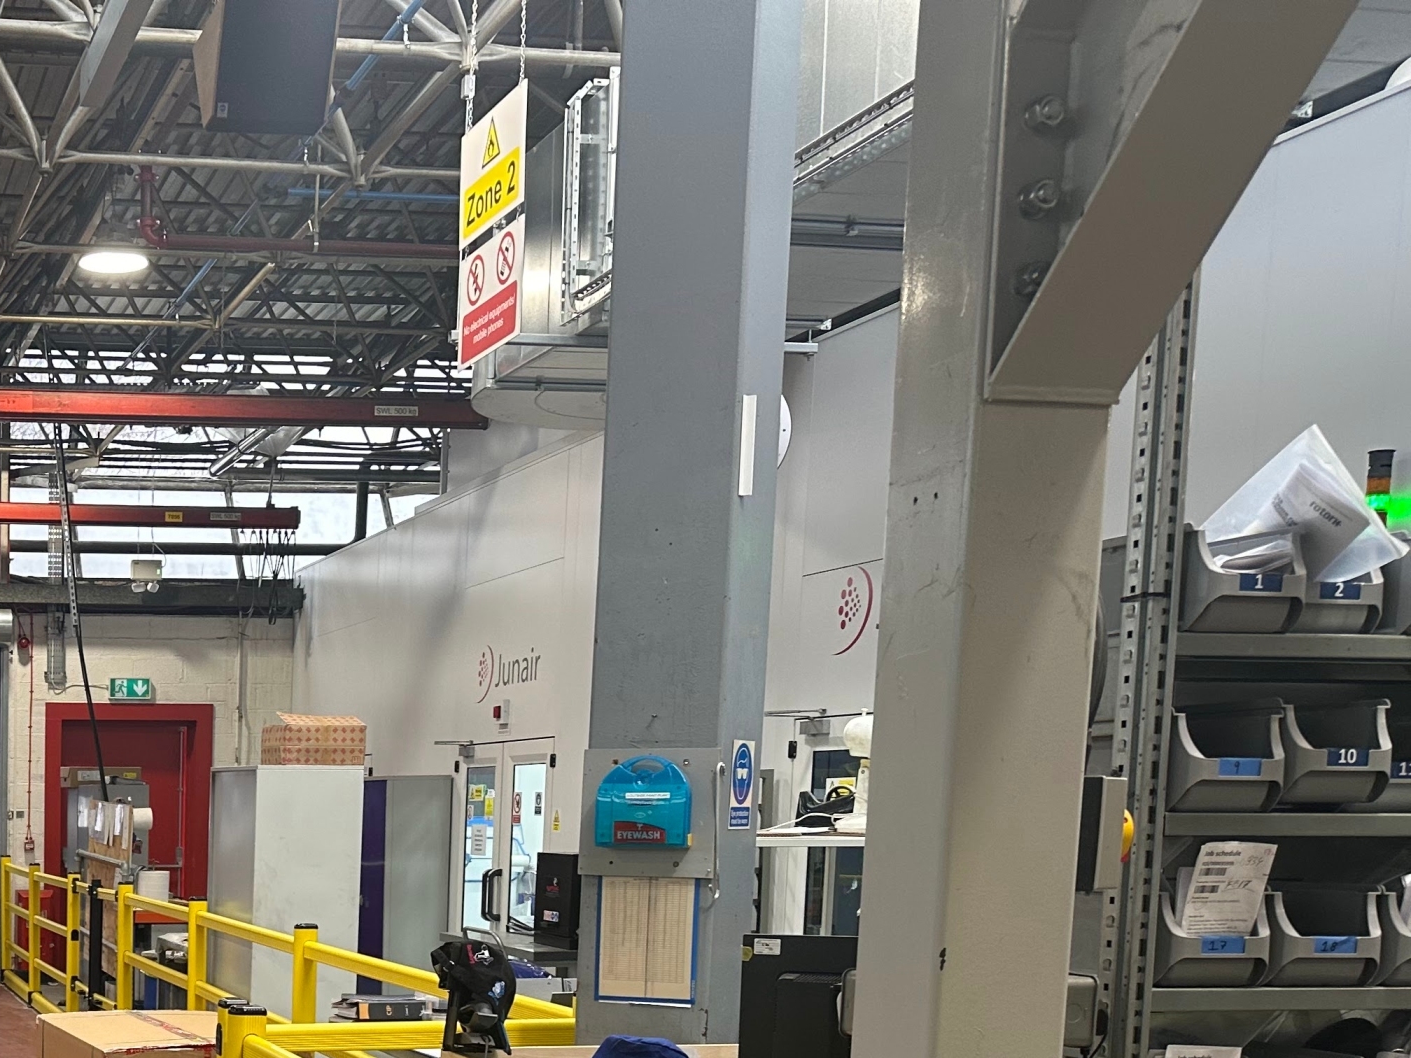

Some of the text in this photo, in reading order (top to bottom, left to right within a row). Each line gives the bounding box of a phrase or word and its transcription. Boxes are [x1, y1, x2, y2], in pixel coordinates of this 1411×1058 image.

[466, 160, 516, 228] Zone 2
[472, 317, 504, 345] mobile phones
[376, 407, 393, 415] SWL
[393, 407, 408, 415] 500
[1309, 500, 1343, 527] rotork
[1254, 573, 1264, 589] 1
[1333, 581, 1345, 598] 2
[494, 646, 541, 688] Junair
[1338, 749, 1357, 765] 10
[617, 830, 661, 840] EYEWASH
[1204, 849, 1242, 857] Job schedule
[1207, 940, 1228, 952] 17
[1319, 941, 1339, 953] 18
